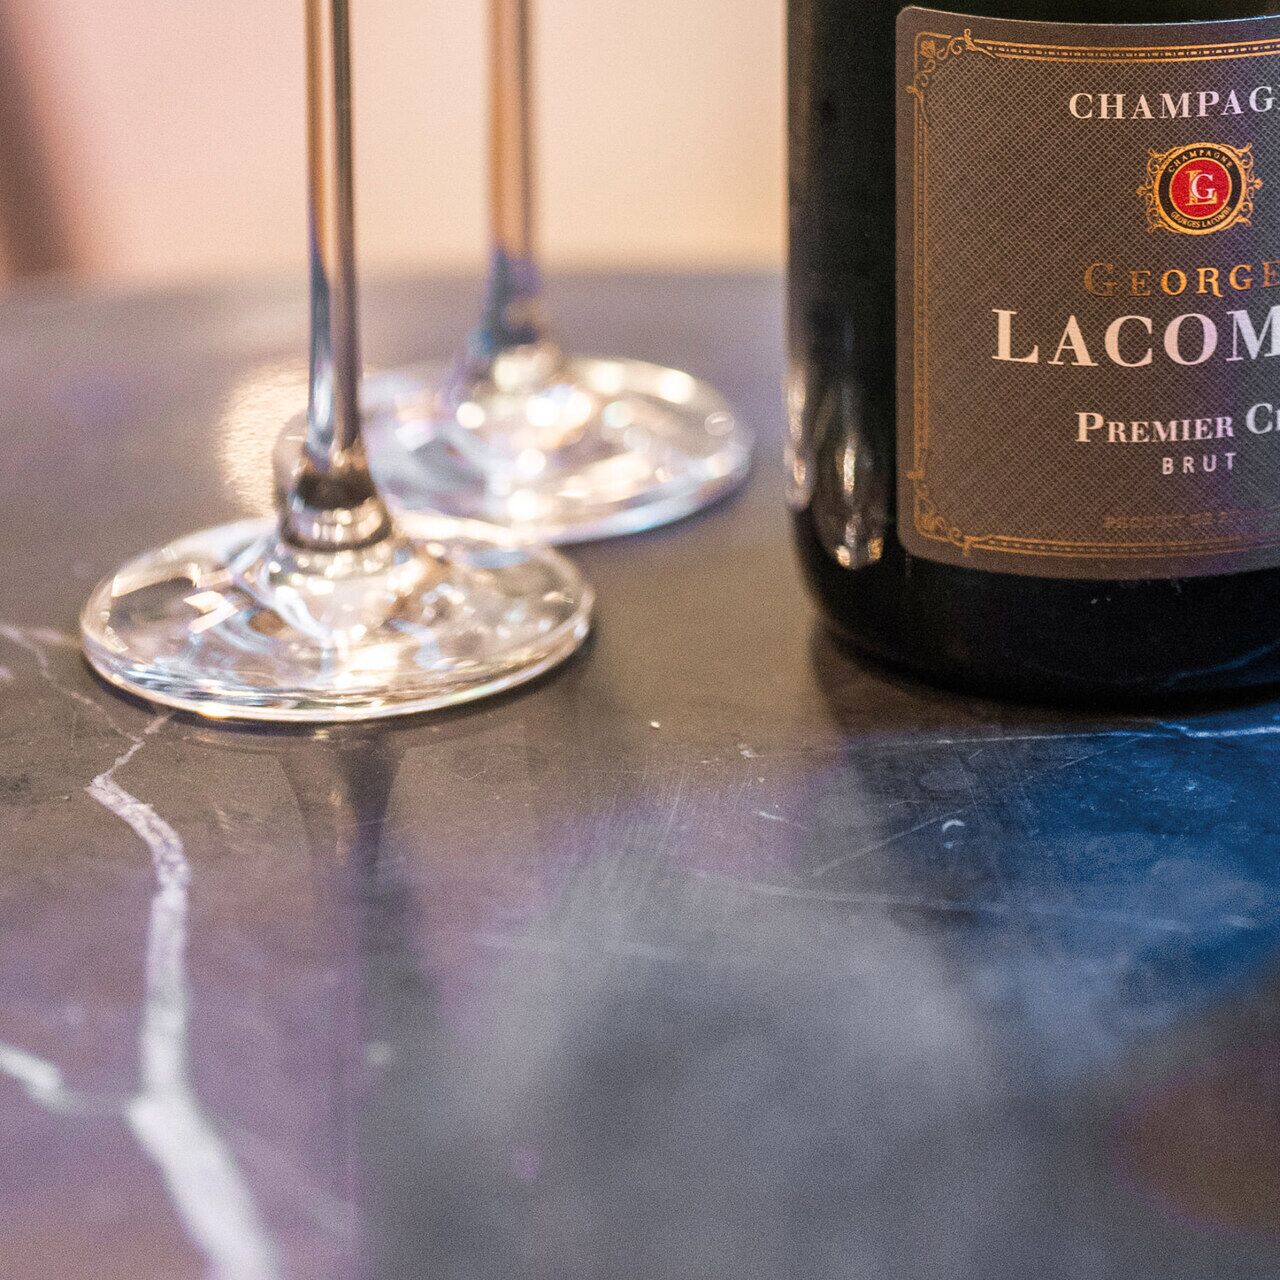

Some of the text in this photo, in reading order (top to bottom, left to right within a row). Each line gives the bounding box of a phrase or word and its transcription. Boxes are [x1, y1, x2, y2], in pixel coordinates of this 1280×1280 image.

[1168, 150, 1234, 174] CHAMPAGNE
[1170, 205, 1232, 228] GEORGES LACOMBE
[1074, 411, 1235, 443] PREMIER
[1162, 452, 1237, 475] BRUT
